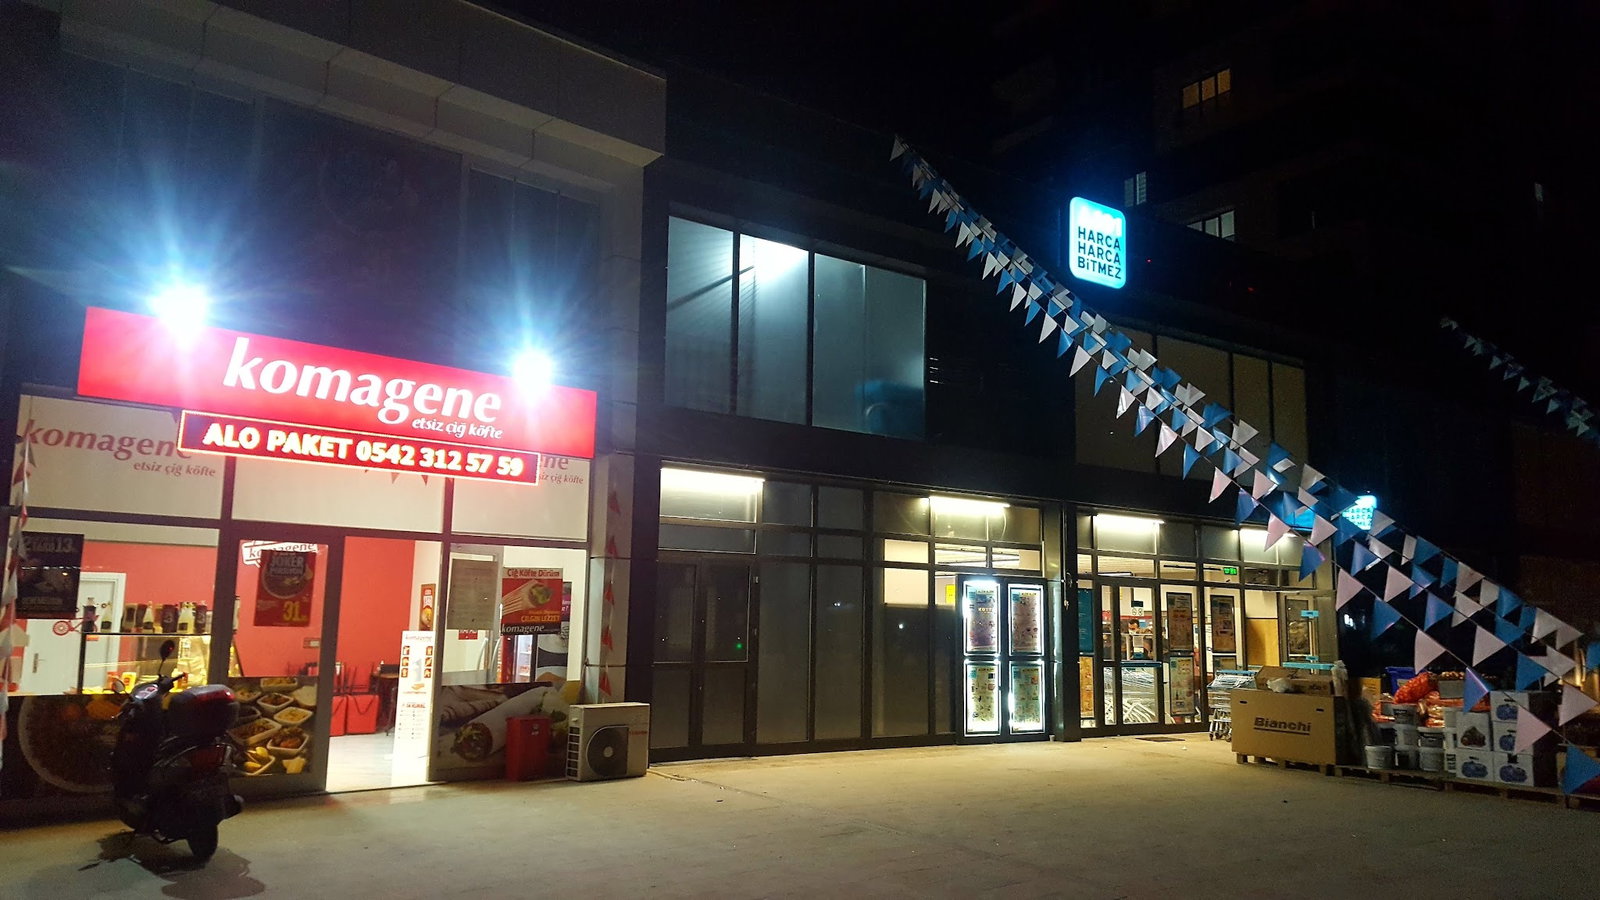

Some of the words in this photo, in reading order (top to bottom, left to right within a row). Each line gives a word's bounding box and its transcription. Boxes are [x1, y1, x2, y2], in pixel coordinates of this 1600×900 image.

[1077, 226, 1121, 251] HARCA
[1077, 241, 1121, 266] HARCA
[222, 337, 502, 425] komagene
[412, 417, 444, 432] etsiz
[445, 420, 467, 438] çiğ
[468, 423, 503, 440] köfte
[202, 422, 261, 450] ALO
[266, 429, 354, 460] PAKET
[355, 440, 415, 467] 0542
[419, 446, 462, 471] 312
[465, 452, 494, 474] 57
[496, 455, 525, 478] 59
[133, 461, 161, 472] etsiz
[185, 462, 217, 477] köfte
[501, 623, 545, 635] komagene
[1254, 717, 1312, 732] Bianchi
